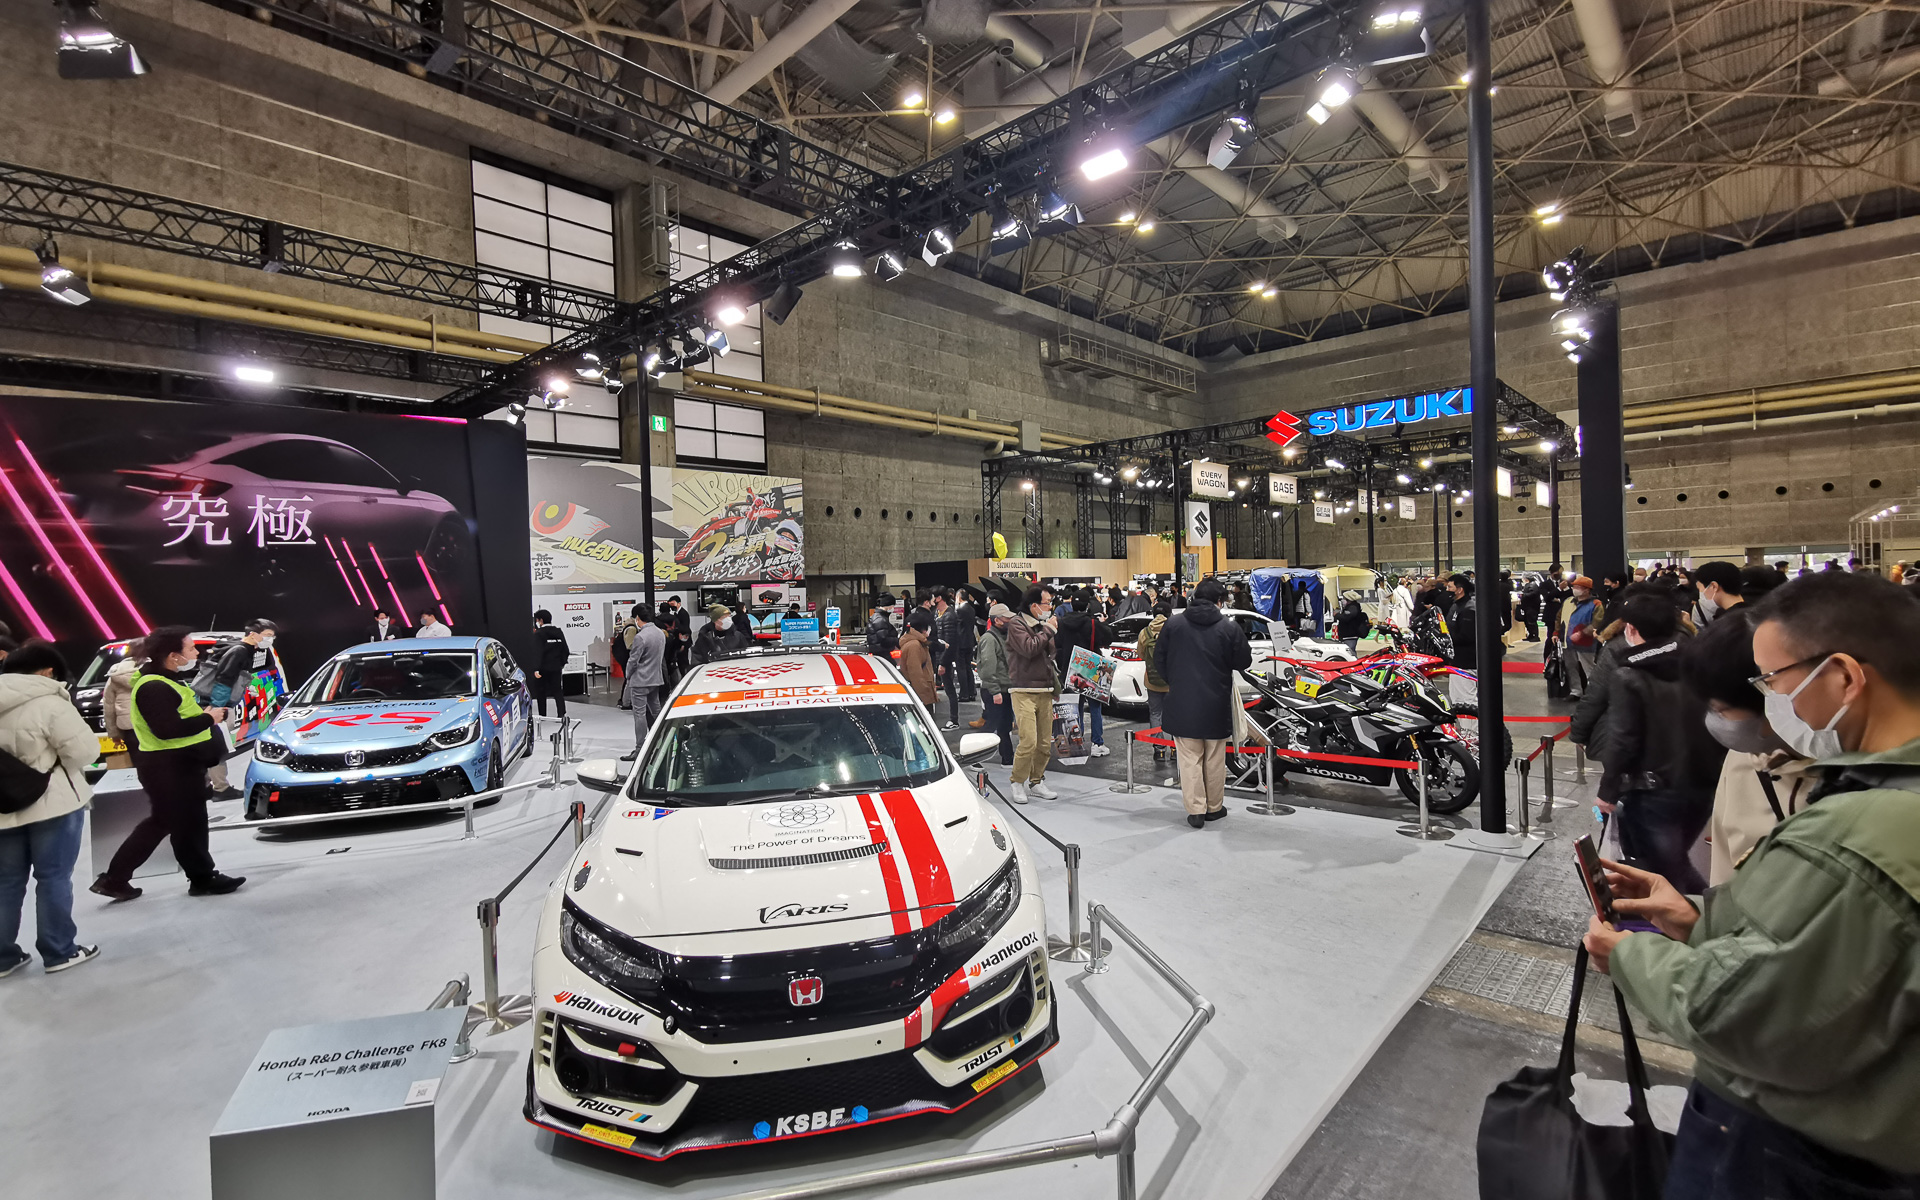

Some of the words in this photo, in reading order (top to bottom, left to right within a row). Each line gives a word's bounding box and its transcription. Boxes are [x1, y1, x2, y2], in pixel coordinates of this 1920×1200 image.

[1308, 387, 1473, 436] SUZUKI
[1197, 477, 1226, 489] WAGON
[1200, 470, 1222, 480] EVERY
[1273, 481, 1294, 495] BASE
[162, 492, 317, 549] 究極
[560, 535, 616, 563] MUGEN
[532, 553, 554, 581] 無限
[565, 603, 590, 611] MOTUL
[1404, 654, 1429, 663] MOTUL
[763, 686, 838, 698] ENEOS
[1303, 684, 1312, 695] 2
[714, 698, 790, 711] Honda
[796, 695, 874, 705] RACING
[294, 711, 441, 733] RS
[1305, 766, 1372, 784] HONDA
[731, 843, 755, 852] The
[757, 838, 799, 850] Power
[801, 836, 813, 844] of
[817, 834, 866, 843] Dreams
[756, 903, 849, 924] VARIS
[258, 1056, 307, 1072] Honda
[310, 1052, 342, 1066] R&D
[345, 1041, 415, 1061] Challenge
[420, 1037, 448, 1051] FK8
[958, 1040, 1006, 1073] TRUST
[307, 1106, 351, 1118] HONDA
[576, 1097, 633, 1117] TRUST
[775, 1107, 846, 1137] KSBF
